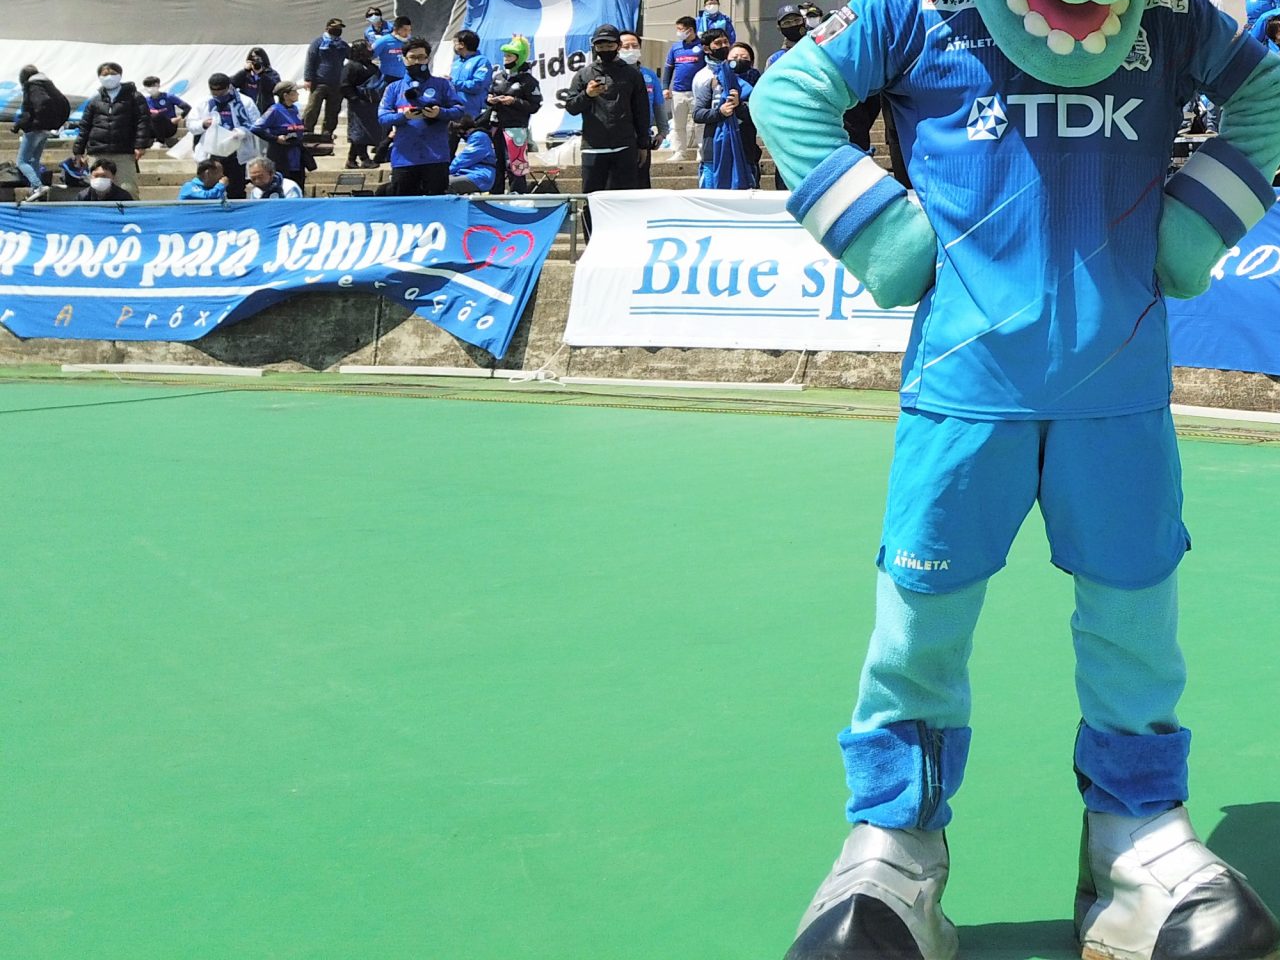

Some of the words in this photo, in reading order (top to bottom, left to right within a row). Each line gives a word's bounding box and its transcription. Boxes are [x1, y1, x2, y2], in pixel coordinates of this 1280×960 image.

[529, 48, 586, 80] ride
[1007, 94, 1144, 140] TDK
[33, 223, 142, 279] você
[139, 228, 260, 286] para
[263, 221, 446, 273] sempre
[632, 235, 779, 298] Blue
[801, 258, 867, 321] sp
[54, 303, 73, 328] A
[115, 304, 232, 329] Próxi
[893, 555, 949, 570] ATHLETA
